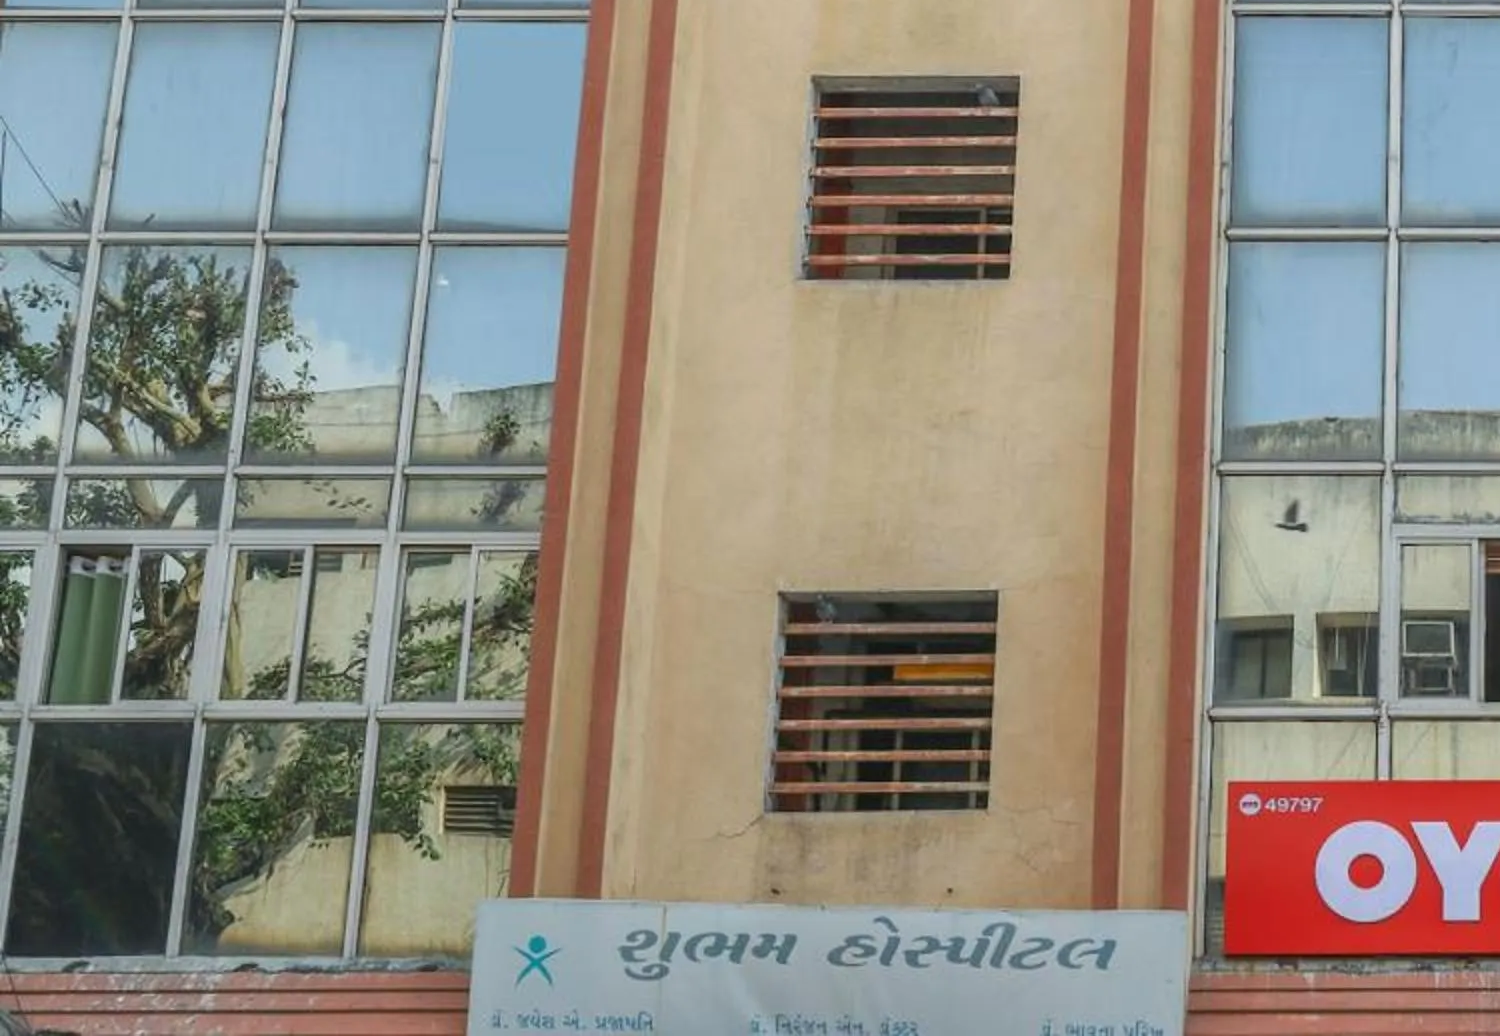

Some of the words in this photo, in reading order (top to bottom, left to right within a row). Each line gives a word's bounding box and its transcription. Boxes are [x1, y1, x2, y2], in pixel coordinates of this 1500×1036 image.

[1264, 797, 1324, 813] 49797
[617, 928, 798, 981] શુભમ
[826, 916, 1117, 971] હોસ્પીટલ
